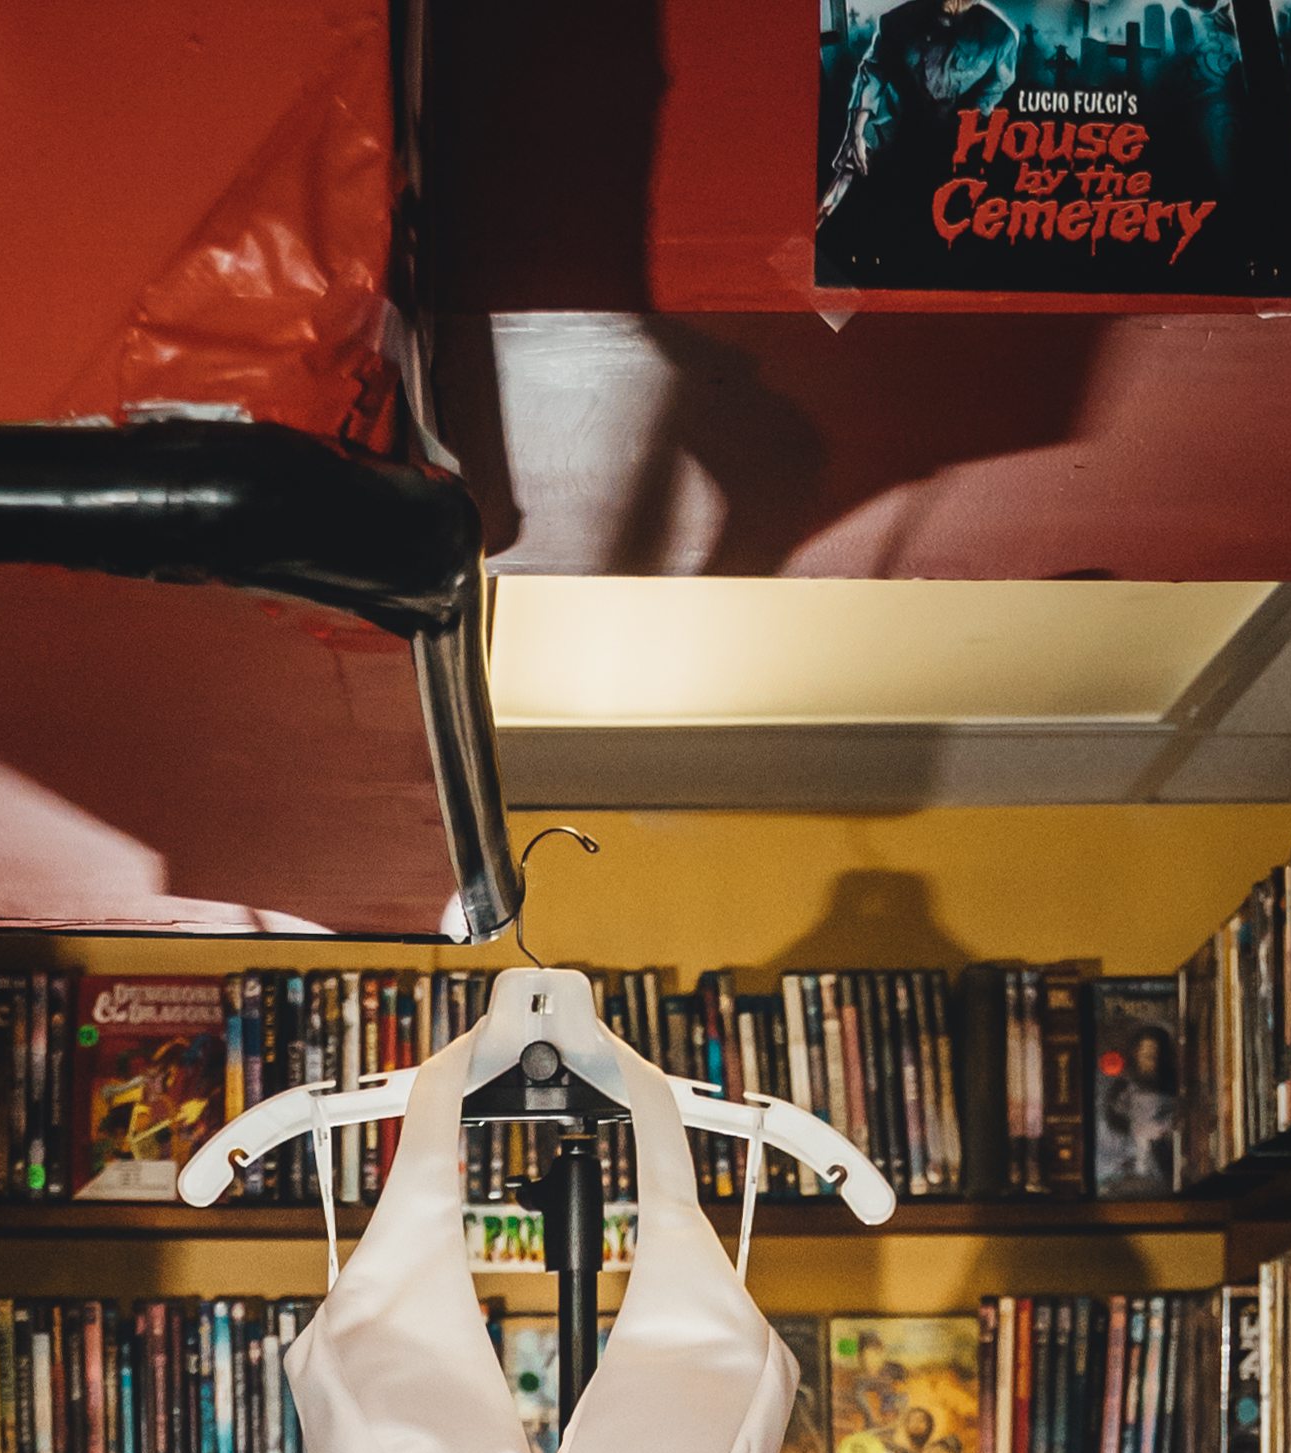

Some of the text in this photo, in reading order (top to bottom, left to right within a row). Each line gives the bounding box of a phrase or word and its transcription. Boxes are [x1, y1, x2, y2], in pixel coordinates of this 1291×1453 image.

[1018, 91, 1138, 115] LUCIO FULCI'S
[953, 107, 1150, 172] House
[1014, 164, 1151, 197] by the
[932, 176, 1217, 264] Cemetery
